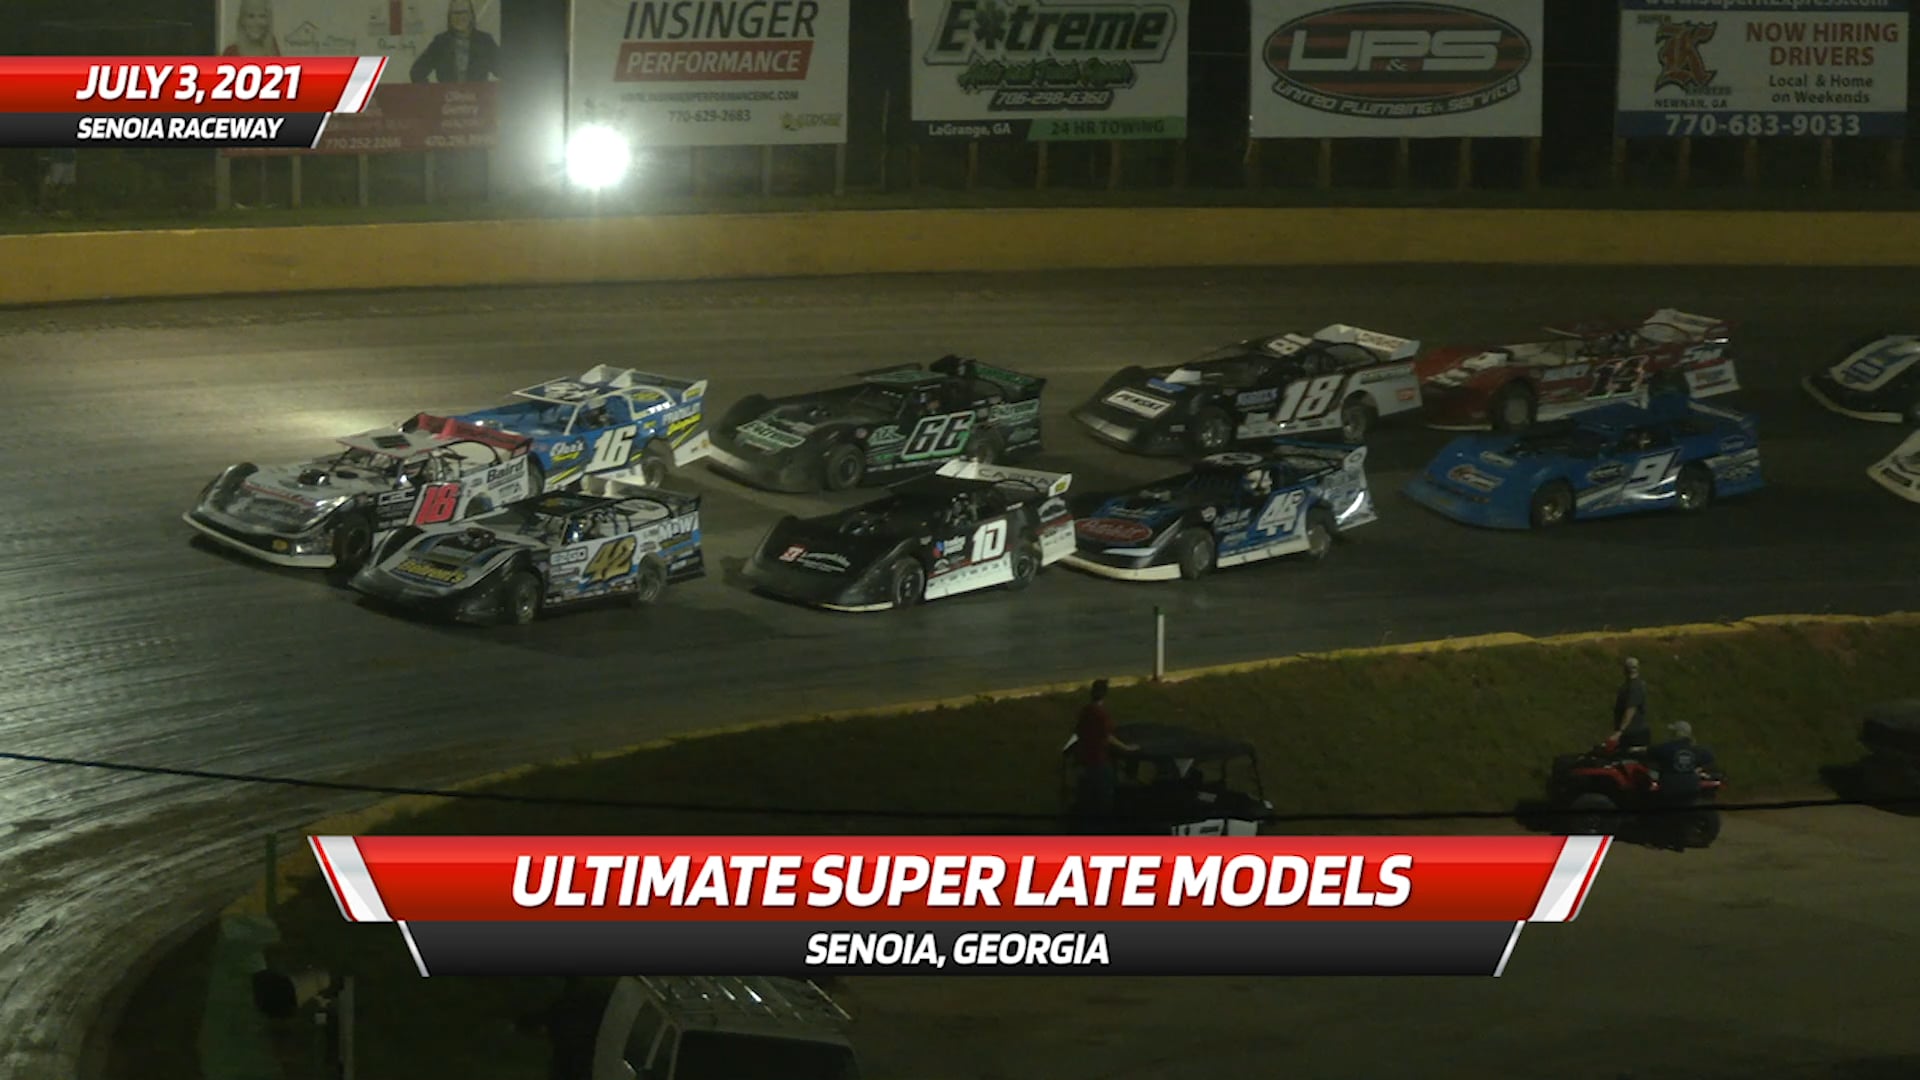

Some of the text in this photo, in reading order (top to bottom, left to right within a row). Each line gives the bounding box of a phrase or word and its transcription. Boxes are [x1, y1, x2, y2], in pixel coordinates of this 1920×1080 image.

[624, 1, 819, 40] INSINGER
[1746, 22, 1899, 42] NOW HIRING
[626, 50, 801, 73] PERFORMANCE
[1288, 30, 1502, 71] UPS
[1769, 47, 1875, 66] DRIVERS
[1768, 75, 1874, 87] Local & Home
[1771, 90, 1871, 104] on Weekends
[928, 123, 1012, 138] LaGrange, GA
[1051, 119, 1165, 136] 24 HR TOWING
[1664, 113, 1861, 136] 770-683-9033
[1275, 374, 1346, 422] 18
[583, 424, 638, 474] 16
[902, 411, 975, 461] 66
[1628, 449, 1680, 485] 9
[415, 481, 461, 526] 16
[583, 534, 638, 584] 42
[972, 519, 1008, 563] 10
